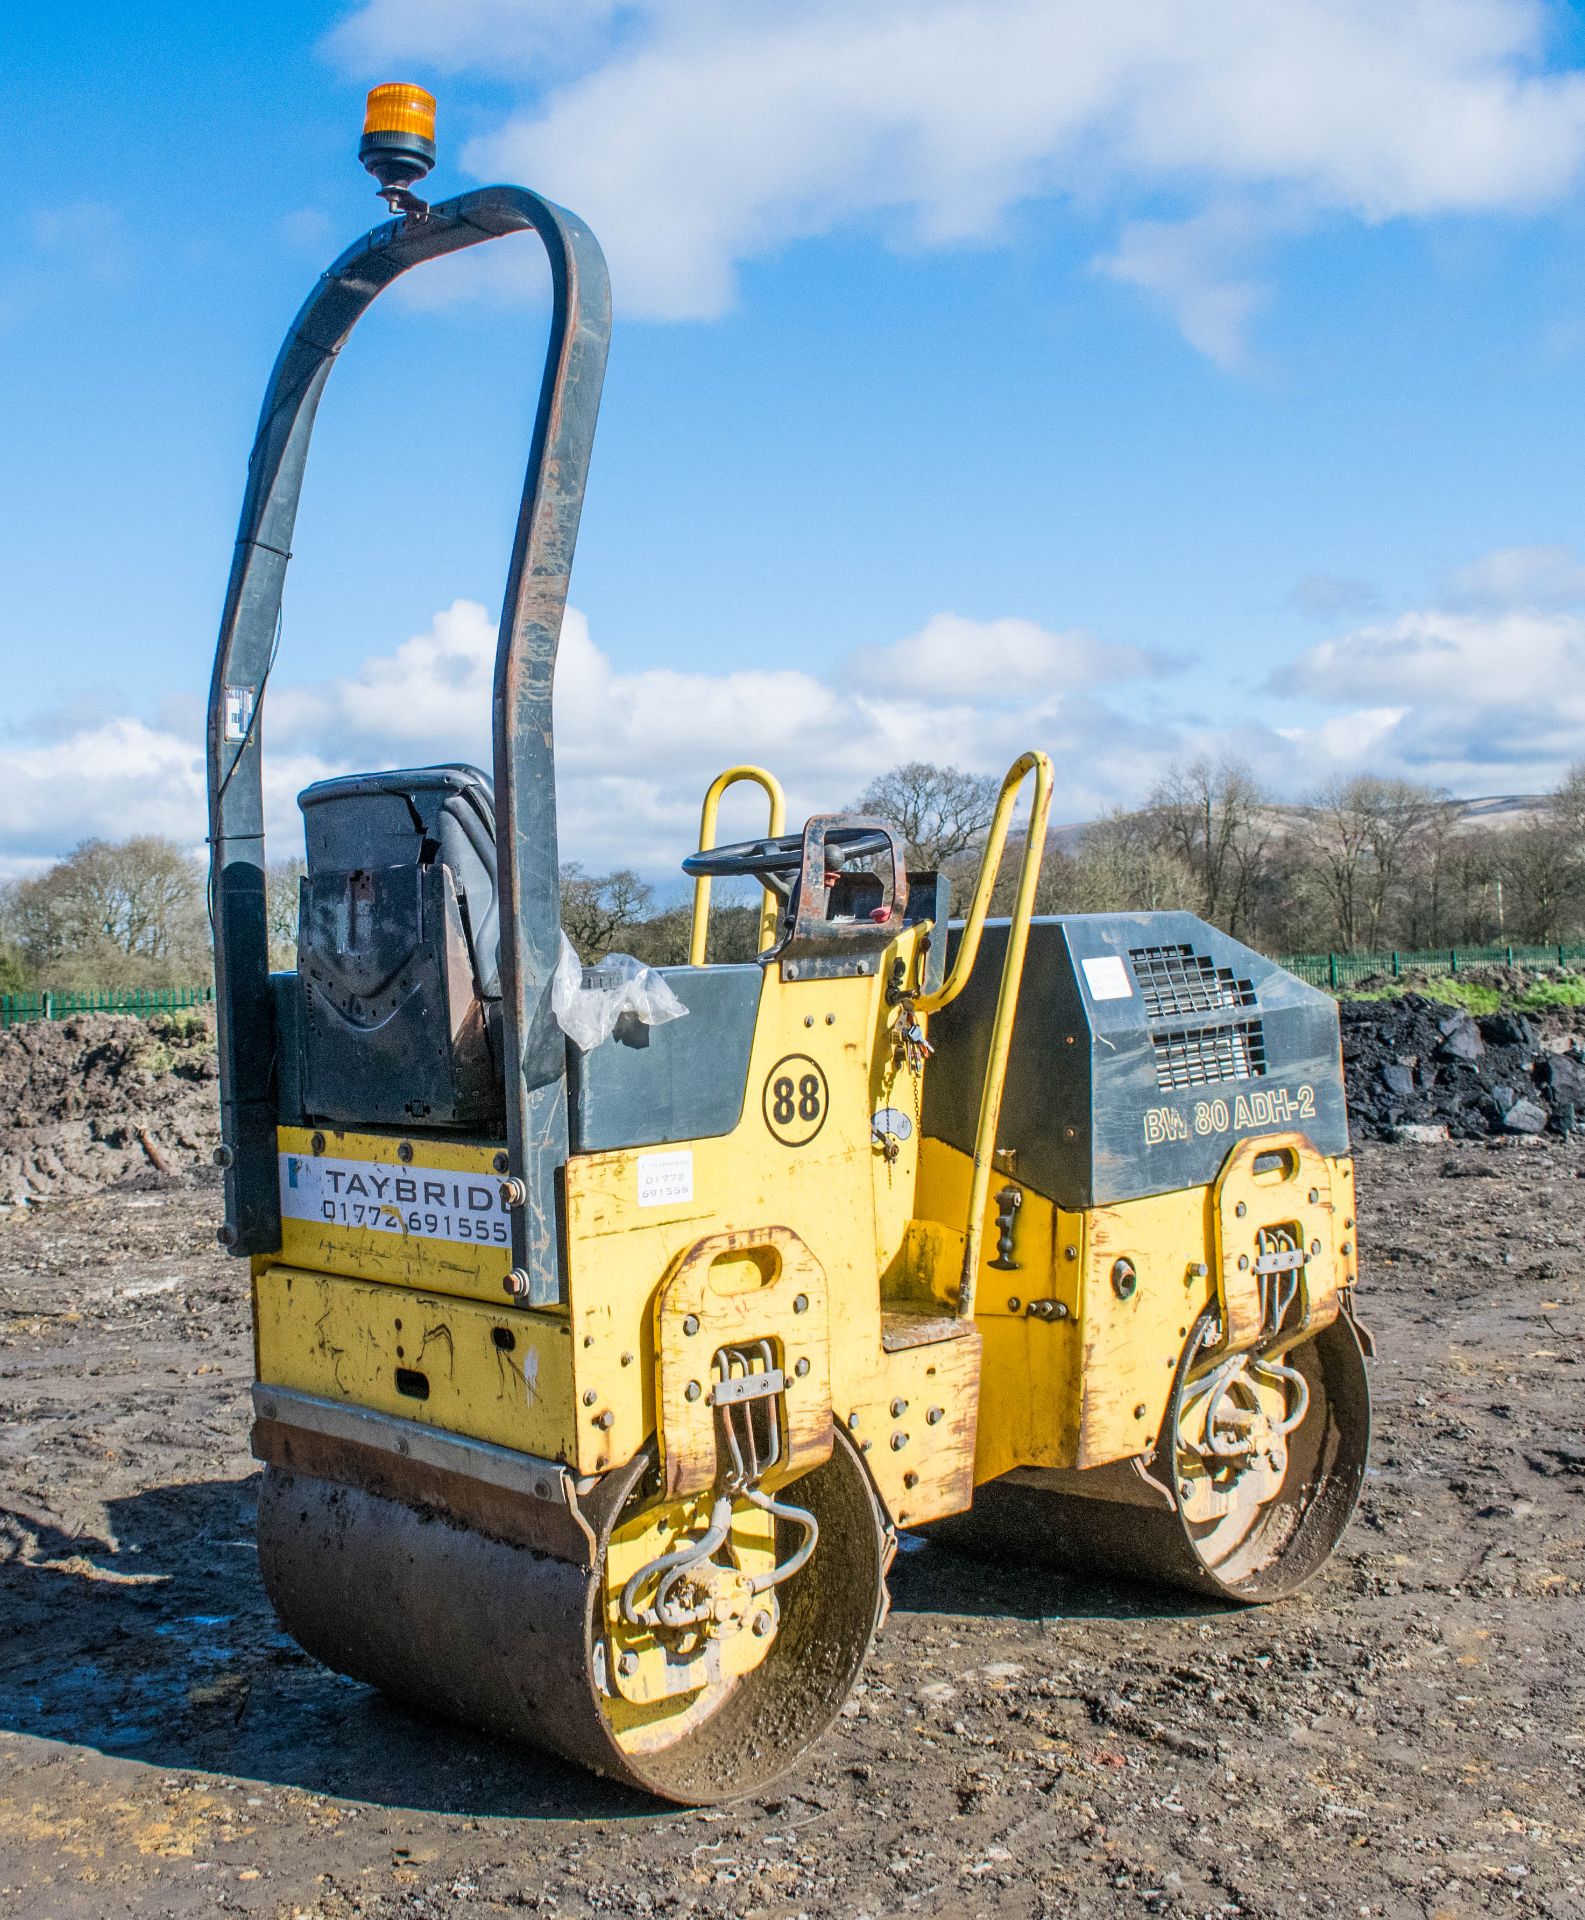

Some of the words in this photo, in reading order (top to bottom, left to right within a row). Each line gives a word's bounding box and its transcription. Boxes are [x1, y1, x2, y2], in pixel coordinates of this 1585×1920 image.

[773, 1073, 820, 1125] 88
[1144, 1107, 1188, 1144] BW
[1195, 1099, 1229, 1135] 80
[1234, 1085, 1316, 1130] ADH-2
[641, 1186, 689, 1198] 691555
[646, 1173, 684, 1185] 01772
[408, 1211, 508, 1242] 691555
